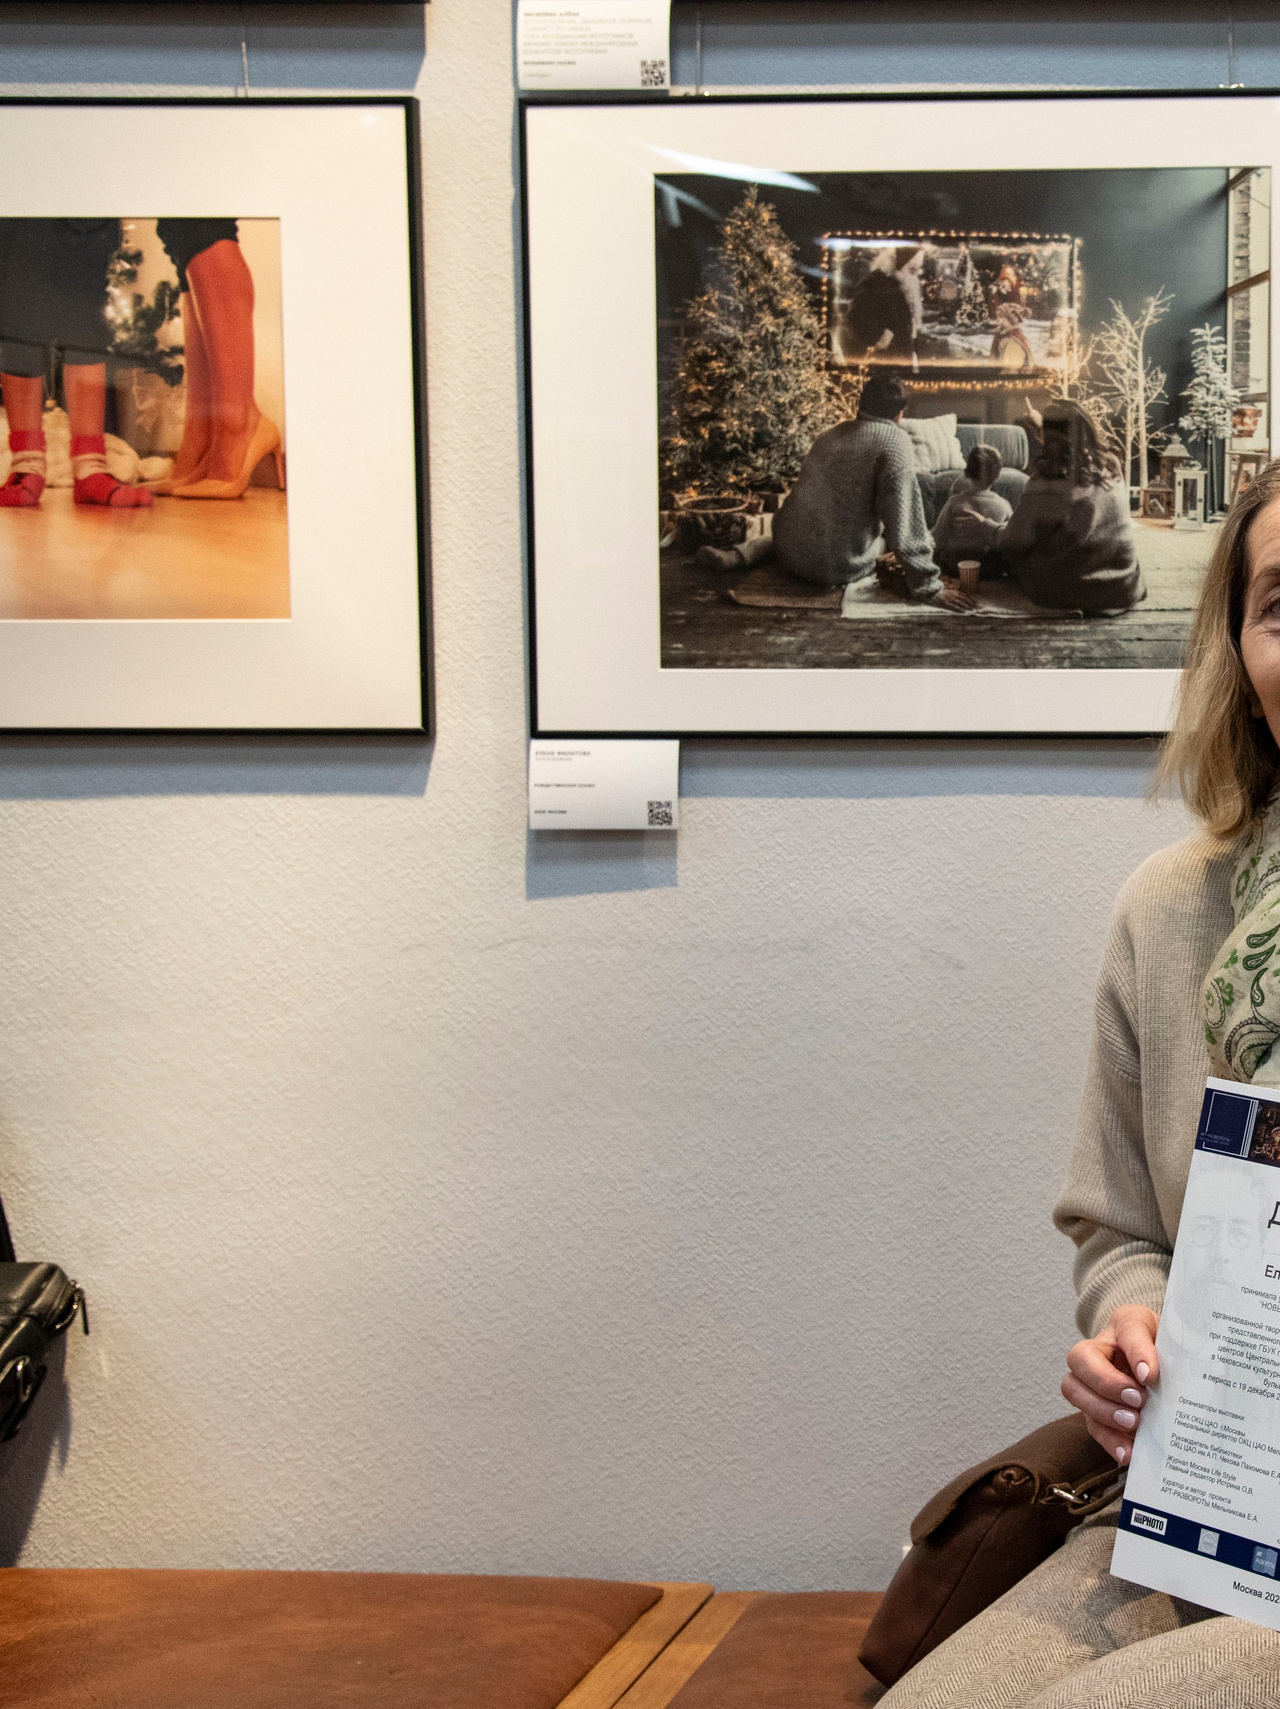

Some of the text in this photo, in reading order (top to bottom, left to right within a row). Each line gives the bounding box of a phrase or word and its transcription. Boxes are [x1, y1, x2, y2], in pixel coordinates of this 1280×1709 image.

[1240, 1286, 1277, 1301] принимала
[1211, 1311, 1264, 1330] организованной
[1208, 1331, 1221, 1340] при
[1221, 1335, 1257, 1350] поддержке
[1258, 1343, 1277, 1355] ГБУК
[1217, 1345, 1245, 1358] центров
[1216, 1354, 1252, 1370] Чеховском
[1207, 1374, 1232, 1388] период
[1238, 1382, 1247, 1391] 19
[1246, 1386, 1275, 1399] декабря
[1178, 1395, 1218, 1413] Организаторы
[1175, 1410, 1191, 1420] ГБУК
[1190, 1415, 1204, 1426] ОКЦ
[1204, 1419, 1218, 1429] ЦАО
[1174, 1417, 1211, 1434] Генеральный
[1210, 1430, 1238, 1443] директор
[1237, 1436, 1252, 1448] ОКЦ
[1252, 1441, 1267, 1451] ЦАО
[1171, 1432, 1243, 1459] Руководитель библиотеки
[1166, 1454, 1237, 1482] Журнал Москва Life Style
[1169, 1439, 1183, 1450] ОКЦ
[1183, 1444, 1197, 1454] ЦАО
[1219, 1454, 1240, 1467] Чехова
[1240, 1461, 1270, 1476] Пахомова
[1165, 1461, 1189, 1474] Главный
[1189, 1470, 1216, 1484] редактор
[1216, 1477, 1241, 1491] Истрина
[1162, 1476, 1185, 1490] Куратор
[1189, 1486, 1206, 1497] автор
[1208, 1492, 1232, 1505] проекта
[1210, 1501, 1246, 1519] Мельникова
[1232, 1580, 1263, 1598] Москва
